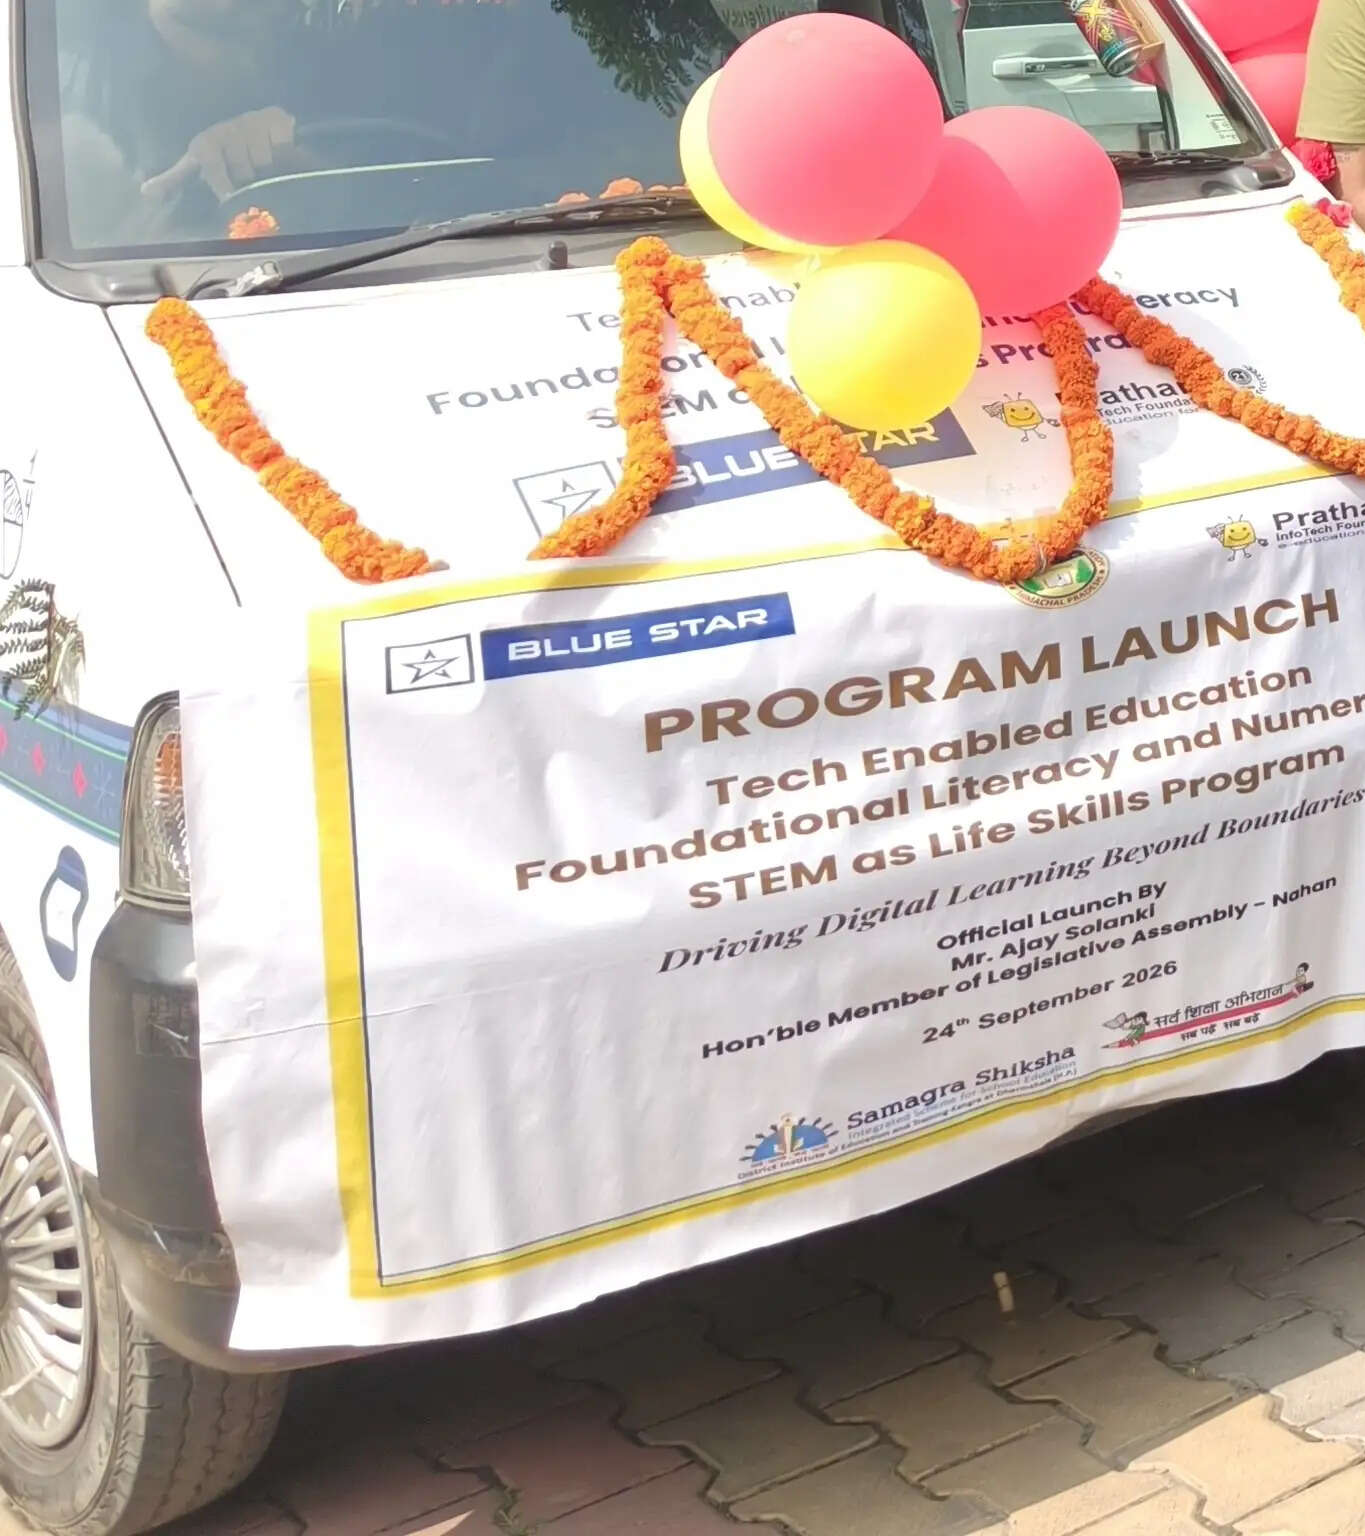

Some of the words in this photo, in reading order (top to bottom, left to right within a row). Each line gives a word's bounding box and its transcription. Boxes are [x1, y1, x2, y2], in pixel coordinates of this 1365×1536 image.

[426, 338, 765, 416] Foundaonl
[585, 388, 718, 429] SM
[990, 330, 1134, 365] Prora
[845, 422, 939, 454] TAR
[1276, 524, 1333, 542] InfoTech
[507, 628, 633, 662] BLUE
[648, 608, 769, 644] STAR
[644, 642, 1063, 753] PROGRAM
[1082, 588, 1340, 673] LAUNCH
[706, 758, 848, 805] Tech
[861, 709, 1073, 777] Enabled
[1085, 666, 1313, 733] Education
[514, 787, 909, 892] Foundational
[922, 747, 1120, 811] Literacy
[1132, 722, 1221, 763] and
[688, 854, 838, 909] STEM
[851, 843, 916, 874] as
[928, 821, 1015, 858] Life
[1028, 789, 1150, 835] Skills
[1161, 743, 1345, 805] Program
[656, 923, 808, 974] Driving
[816, 888, 939, 937] Digital
[945, 855, 1095, 907] Learning
[1100, 825, 1208, 870] Beyond
[1217, 785, 1365, 840] Boundaries
[936, 914, 1034, 951] Official
[1040, 889, 1133, 925] Launch
[1138, 880, 1168, 904] By
[827, 983, 950, 1027] Member
[955, 972, 983, 994] of
[987, 934, 1126, 985] Legislative
[1132, 901, 1249, 944] Assembly
[1271, 876, 1338, 908] Nahan
[951, 949, 993, 972] Mr.
[1000, 930, 1060, 961] Ajay
[1065, 903, 1156, 940] Solanki
[978, 977, 1115, 1030] September
[1121, 960, 1178, 989] 2026
[847, 1080, 966, 1131] Samagra
[975, 1046, 1077, 1086] Shiksha
